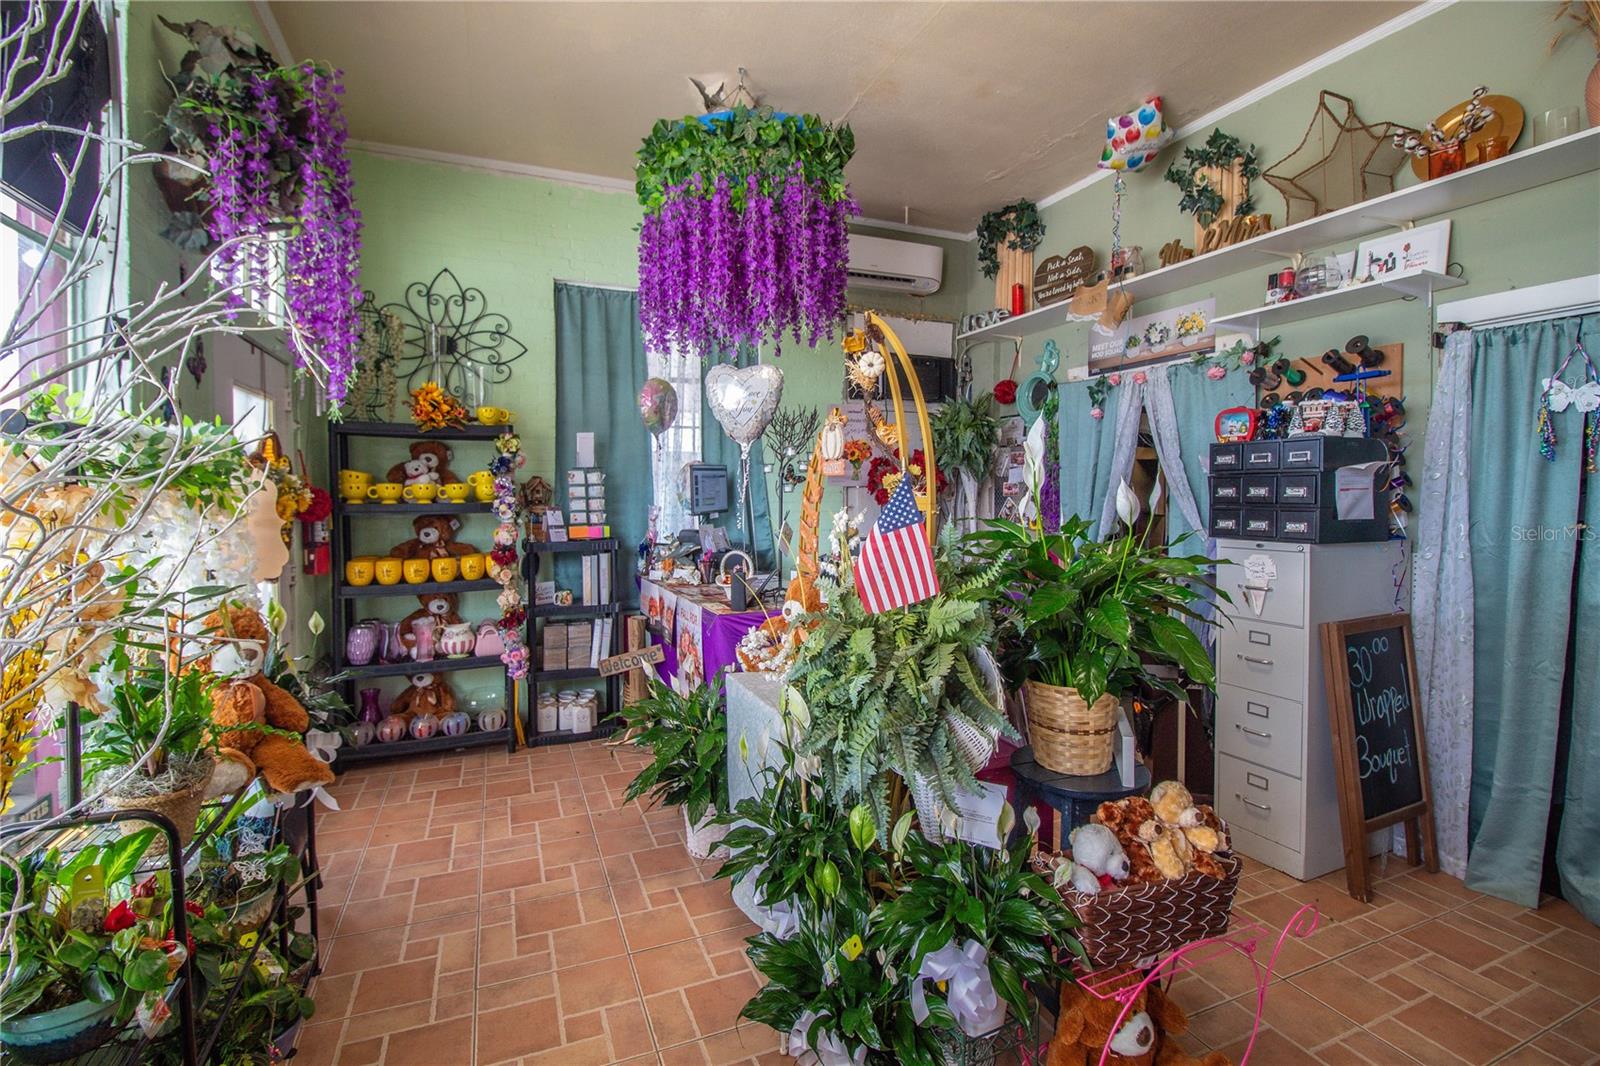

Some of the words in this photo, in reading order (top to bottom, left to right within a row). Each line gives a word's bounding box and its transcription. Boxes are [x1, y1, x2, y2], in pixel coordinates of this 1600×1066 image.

[1046, 260, 1060, 271] Pick
[600, 651, 657, 674] Welcome
[1355, 730, 1412, 784] Bouquet
